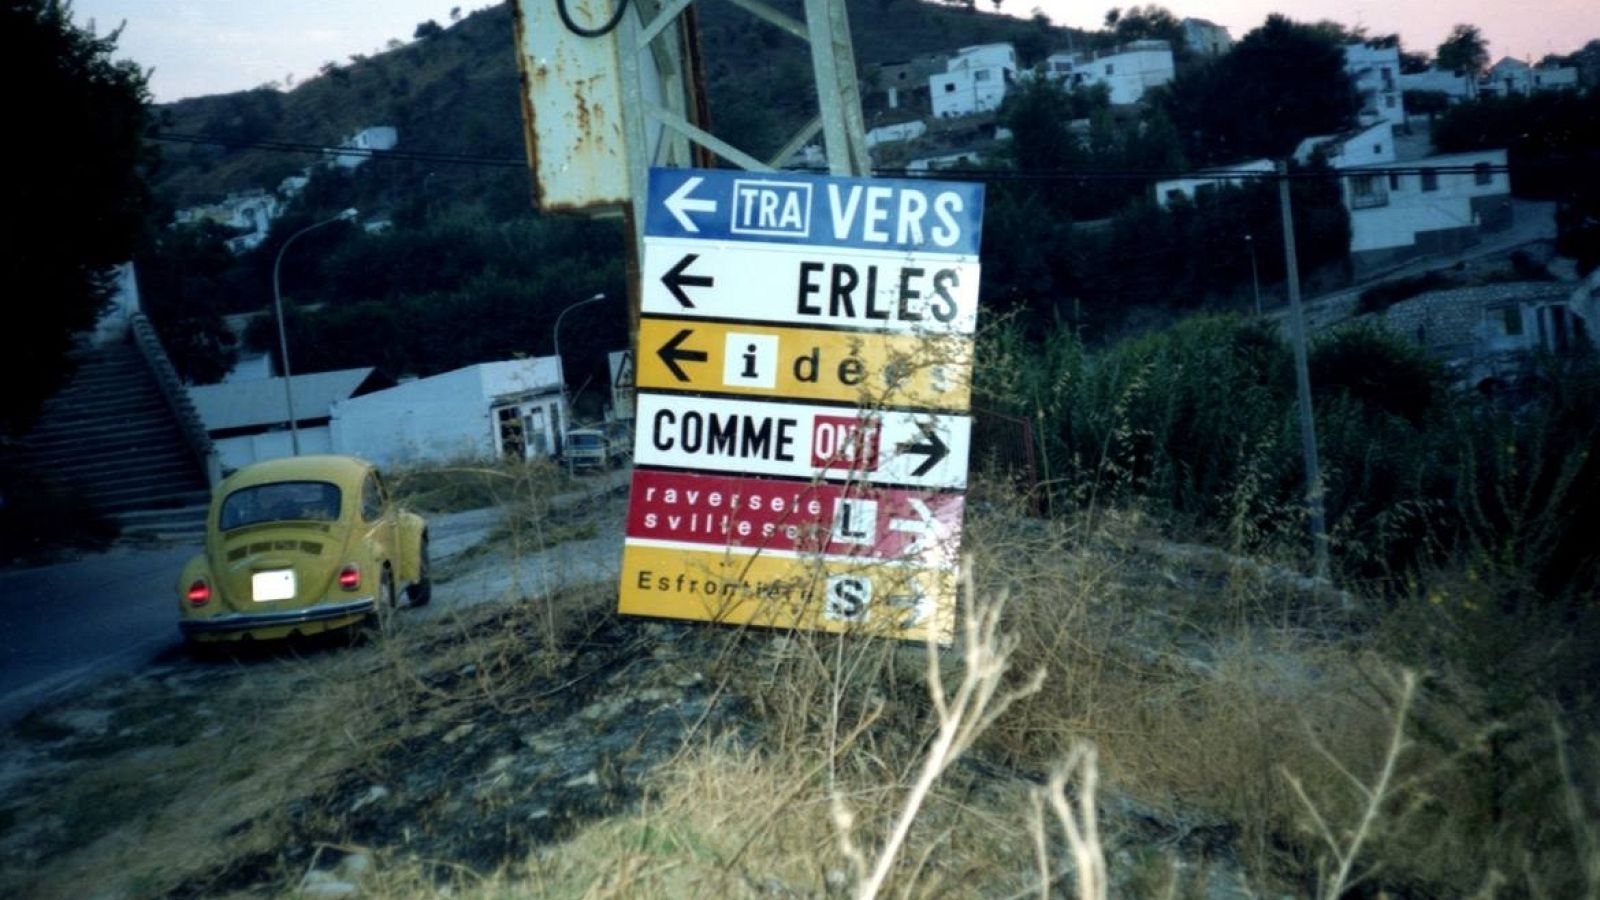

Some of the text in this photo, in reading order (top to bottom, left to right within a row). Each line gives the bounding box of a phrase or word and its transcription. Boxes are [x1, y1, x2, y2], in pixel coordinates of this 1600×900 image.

[740, 183, 964, 247] TRA VERS
[797, 261, 960, 323] ERLES
[652, 409, 798, 462] COMME
